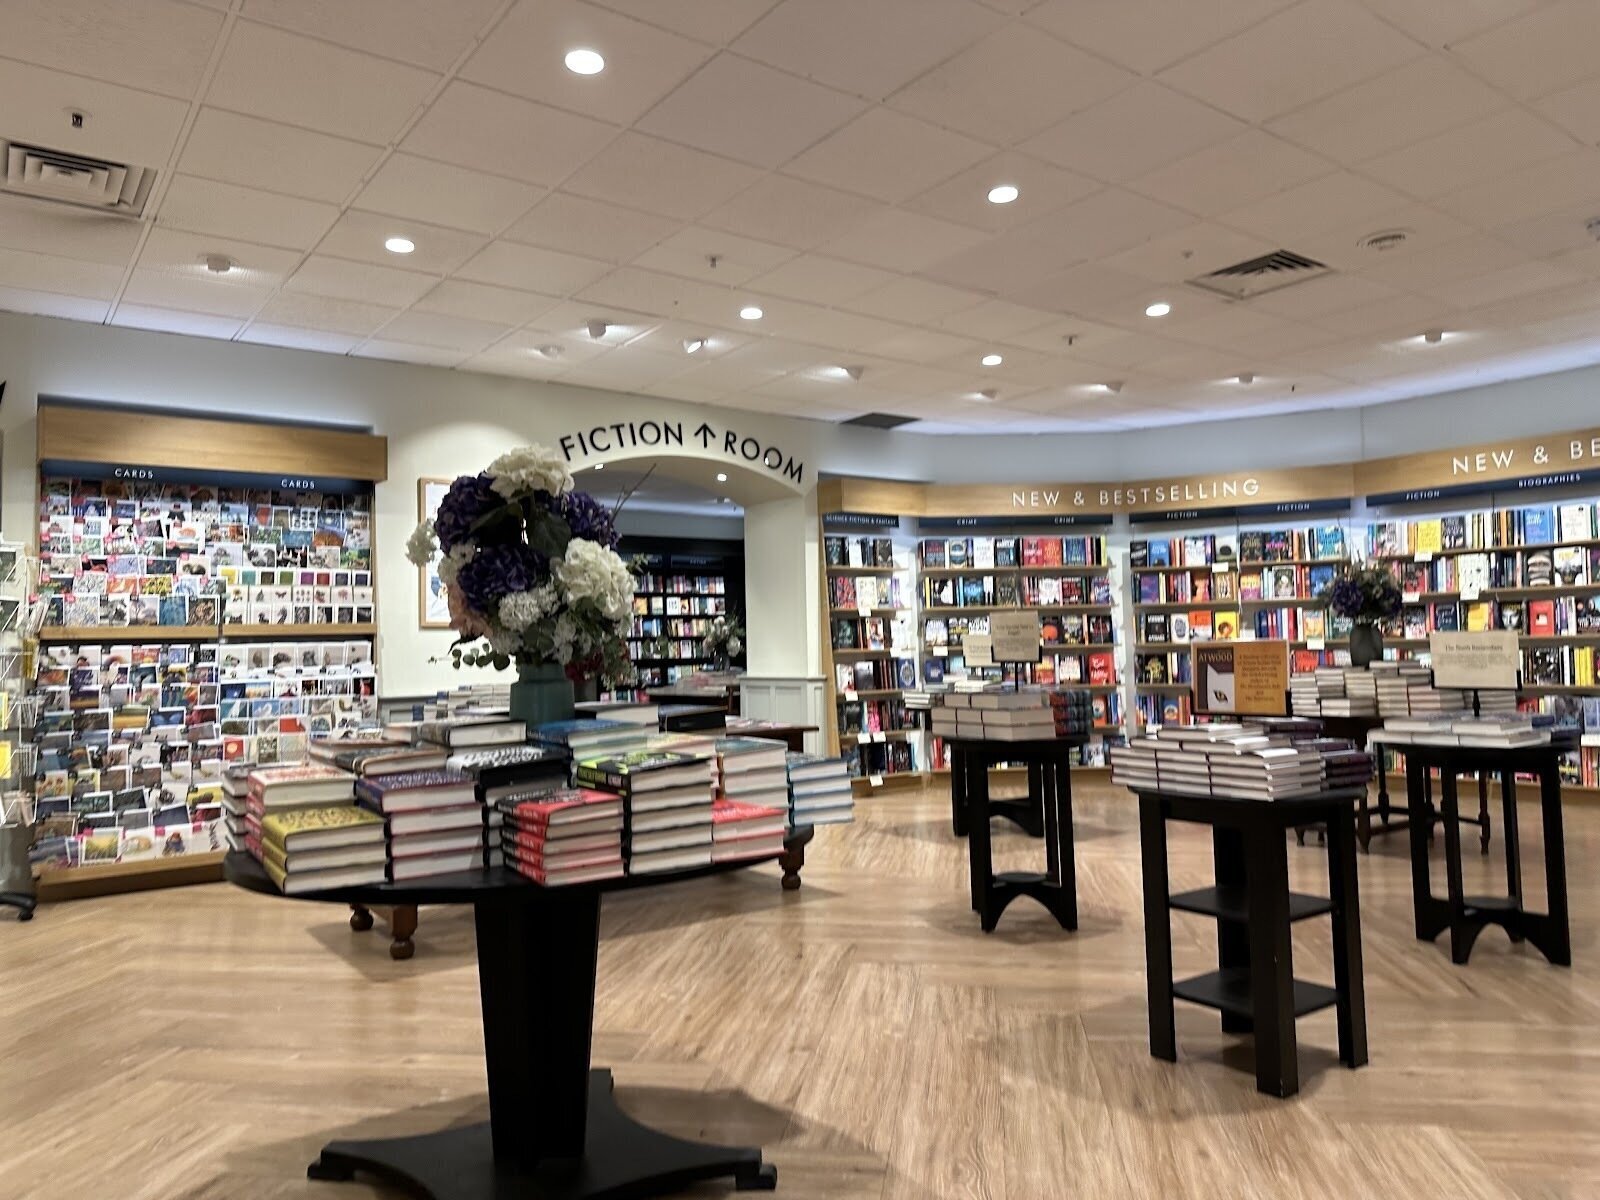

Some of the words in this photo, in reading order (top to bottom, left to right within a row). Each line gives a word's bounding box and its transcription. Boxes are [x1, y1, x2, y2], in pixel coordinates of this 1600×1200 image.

[559, 421, 683, 461] FICTION
[724, 430, 803, 483] ROOM
[1453, 449, 1514, 475] NEW
[1533, 445, 1548, 464] &
[114, 468, 154, 479] CARDS
[281, 478, 315, 489] CARDS
[1518, 473, 1581, 488] BIOGRAPHIES
[1012, 490, 1060, 507] NEW
[1073, 490, 1084, 506] &
[1100, 478, 1259, 506] BESTSELLING
[1406, 490, 1440, 500] FICTION
[1277, 503, 1310, 512] FICTION
[1054, 516, 1074, 524] CRIME
[1166, 511, 1198, 520] FICTION
[956, 518, 977, 526] CRIME
